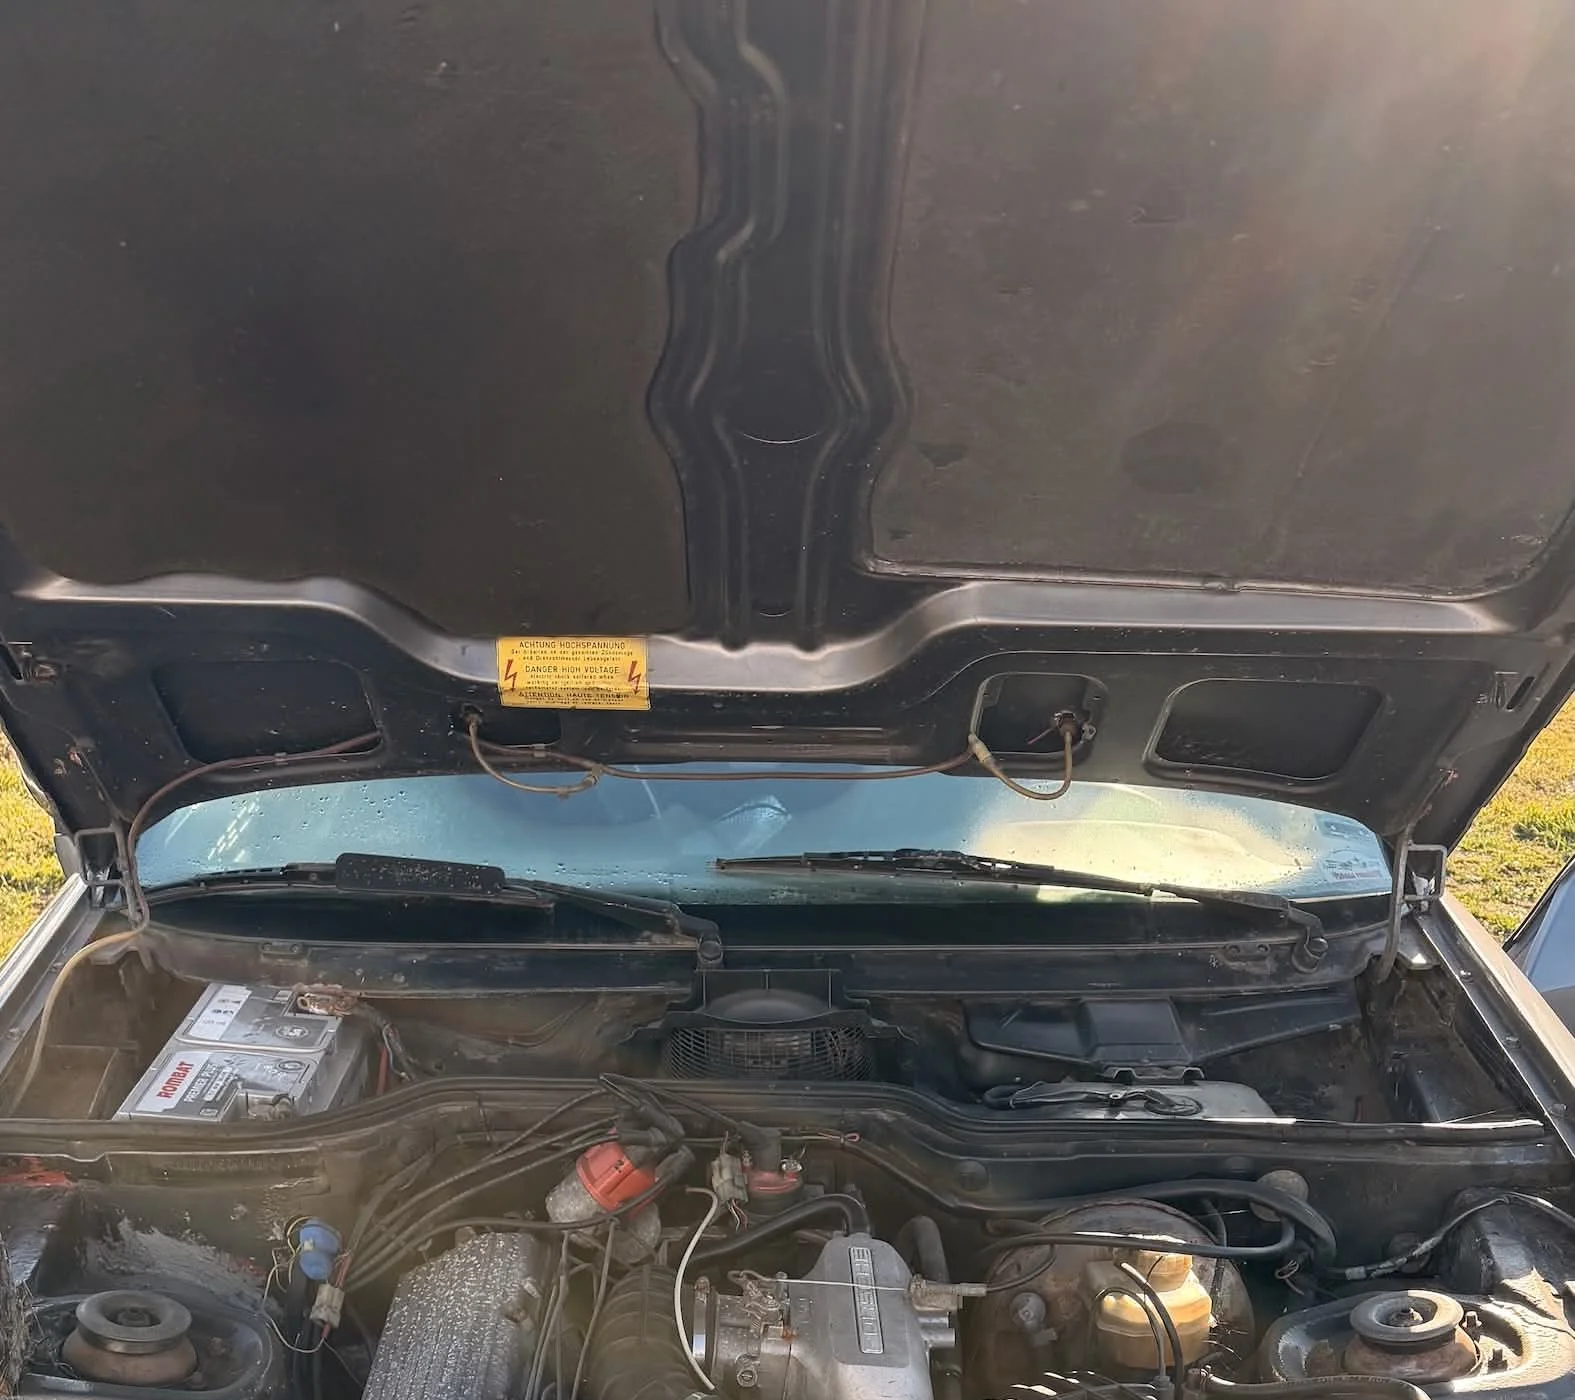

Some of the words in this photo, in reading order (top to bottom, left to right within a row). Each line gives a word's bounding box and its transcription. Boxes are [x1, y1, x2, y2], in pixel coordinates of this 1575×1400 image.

[519, 641, 556, 649] ACHTUNG
[560, 641, 625, 649] HOCHSPANNUNG
[562, 666, 581, 674] HIGH
[585, 666, 620, 674] VOLTAGE
[156, 1061, 194, 1099] ROMBAT
